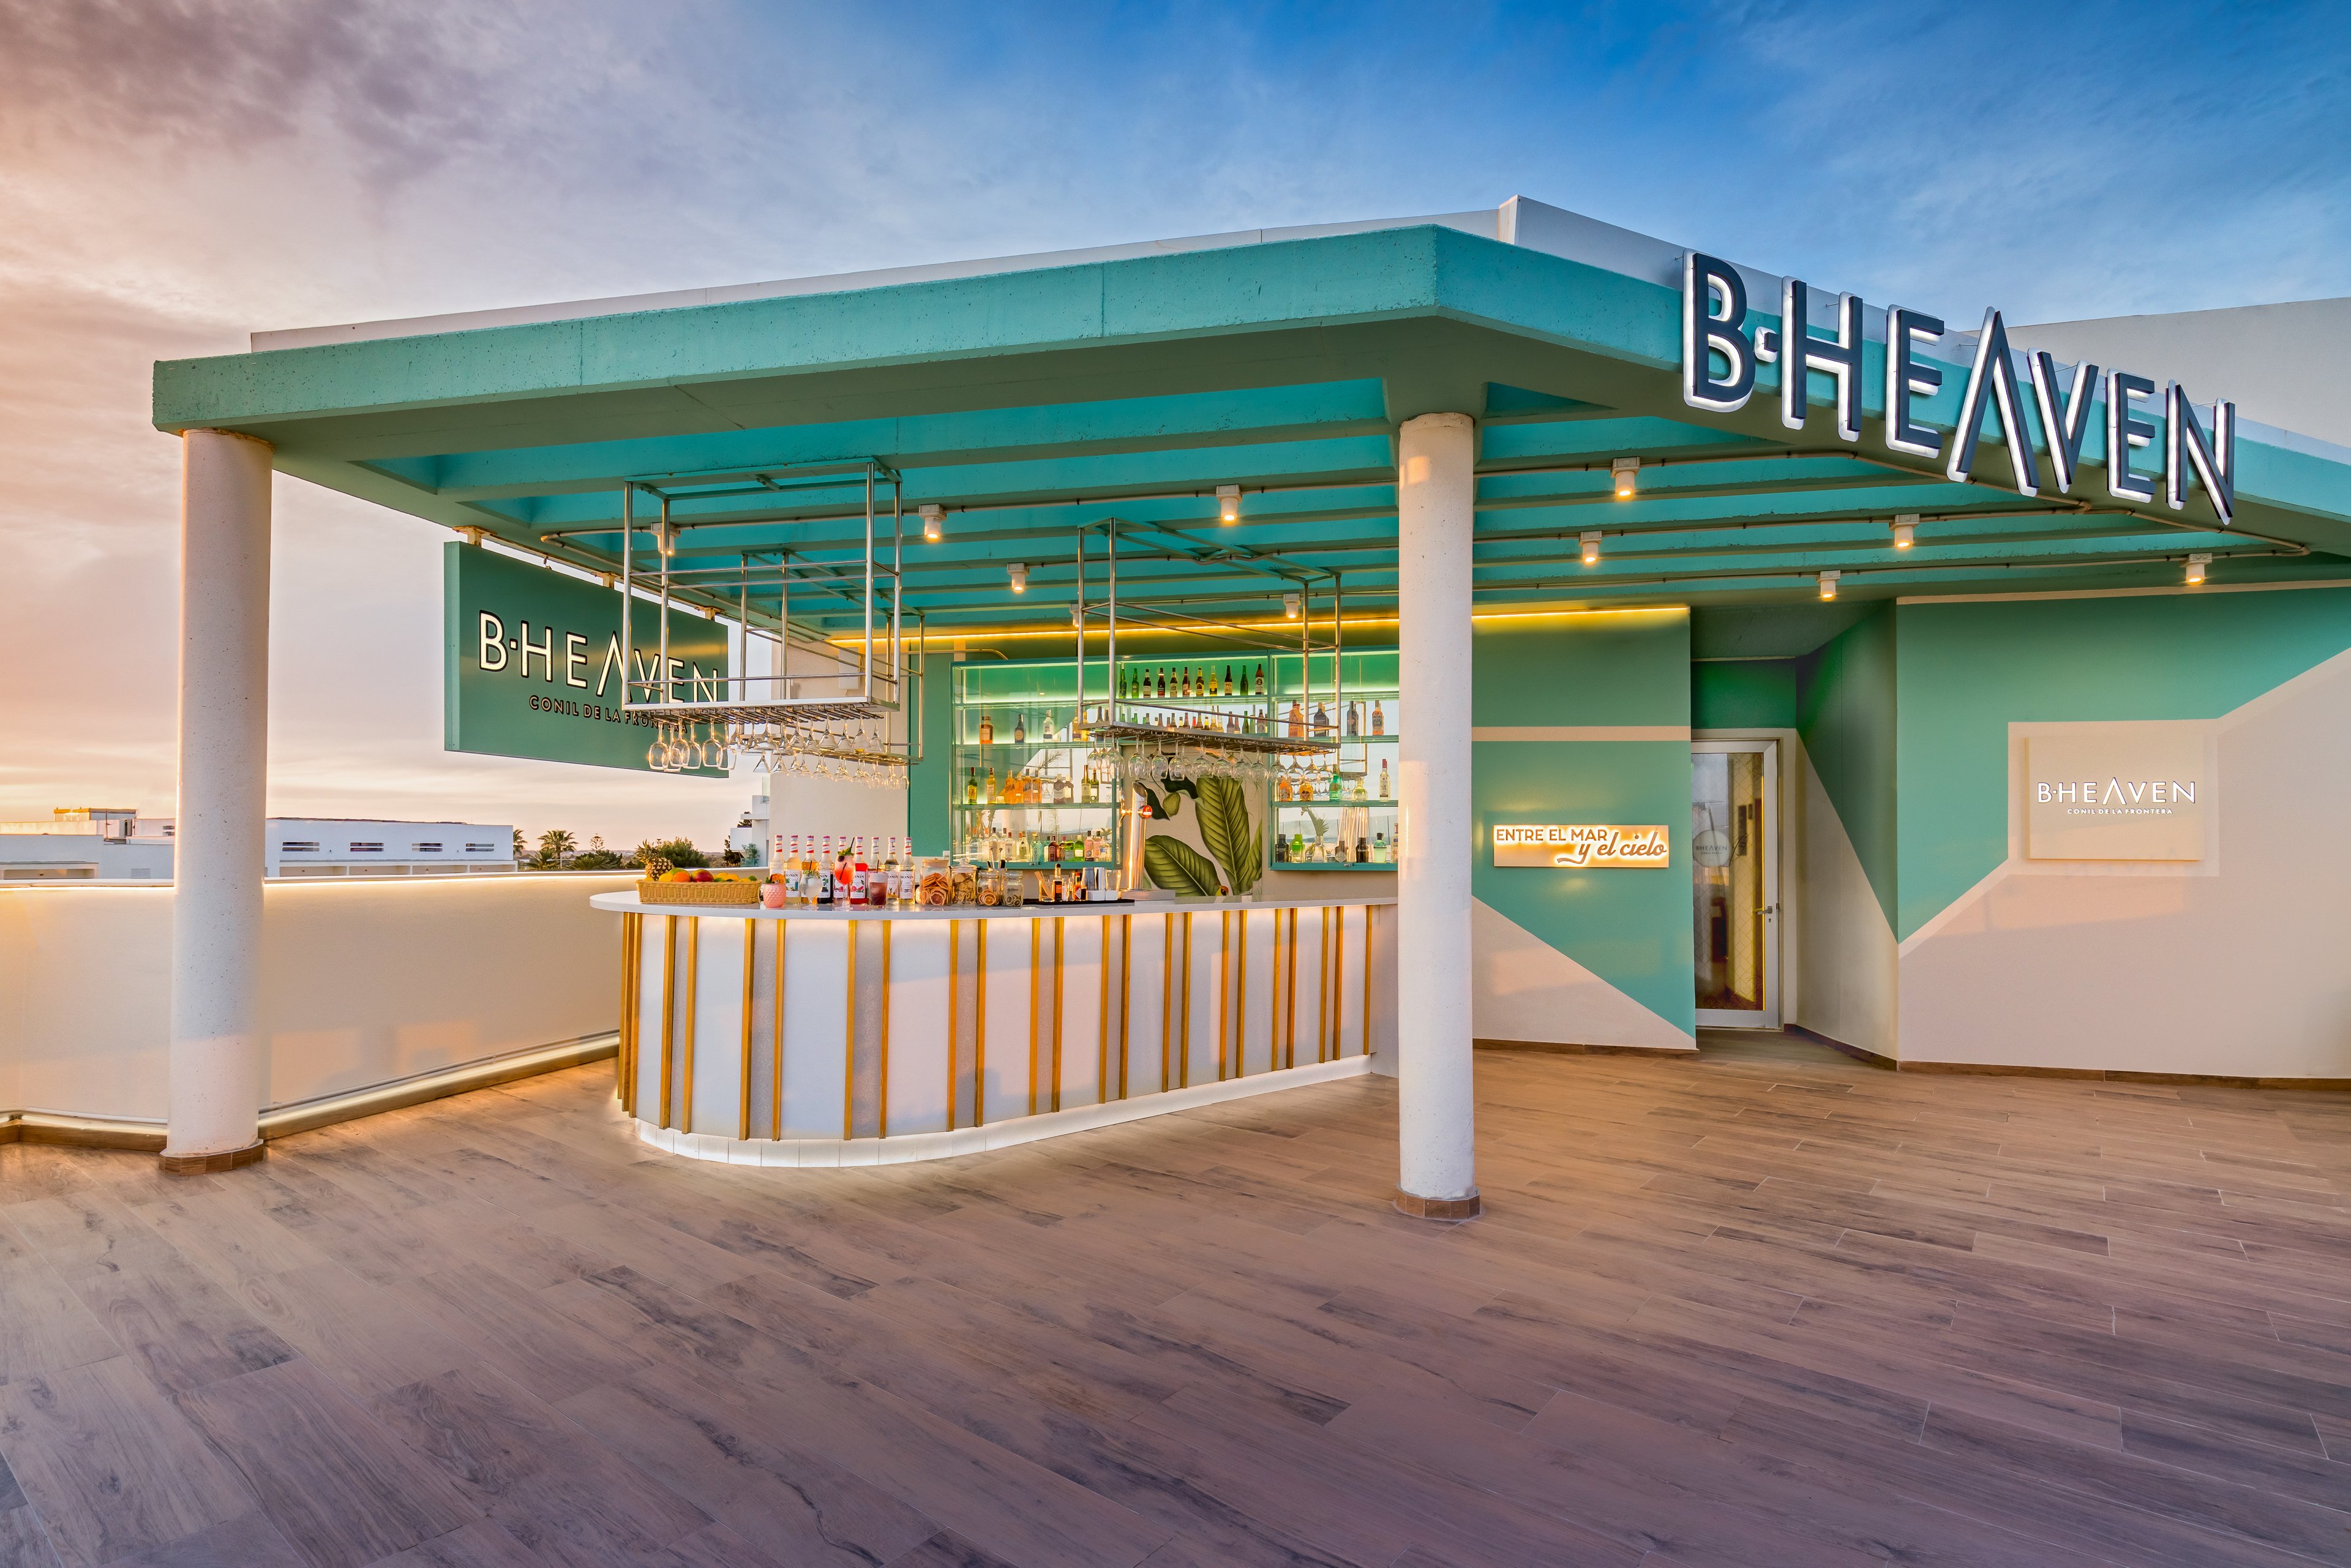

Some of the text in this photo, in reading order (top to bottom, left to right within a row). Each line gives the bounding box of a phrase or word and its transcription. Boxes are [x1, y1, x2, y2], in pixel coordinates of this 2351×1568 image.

[530, 695, 579, 716] CONIL
[583, 704, 601, 719] DE
[606, 708, 621, 723] LA
[1496, 829, 1608, 841] ENTRE EL MAR
[1556, 831, 1667, 865] y el cielo
